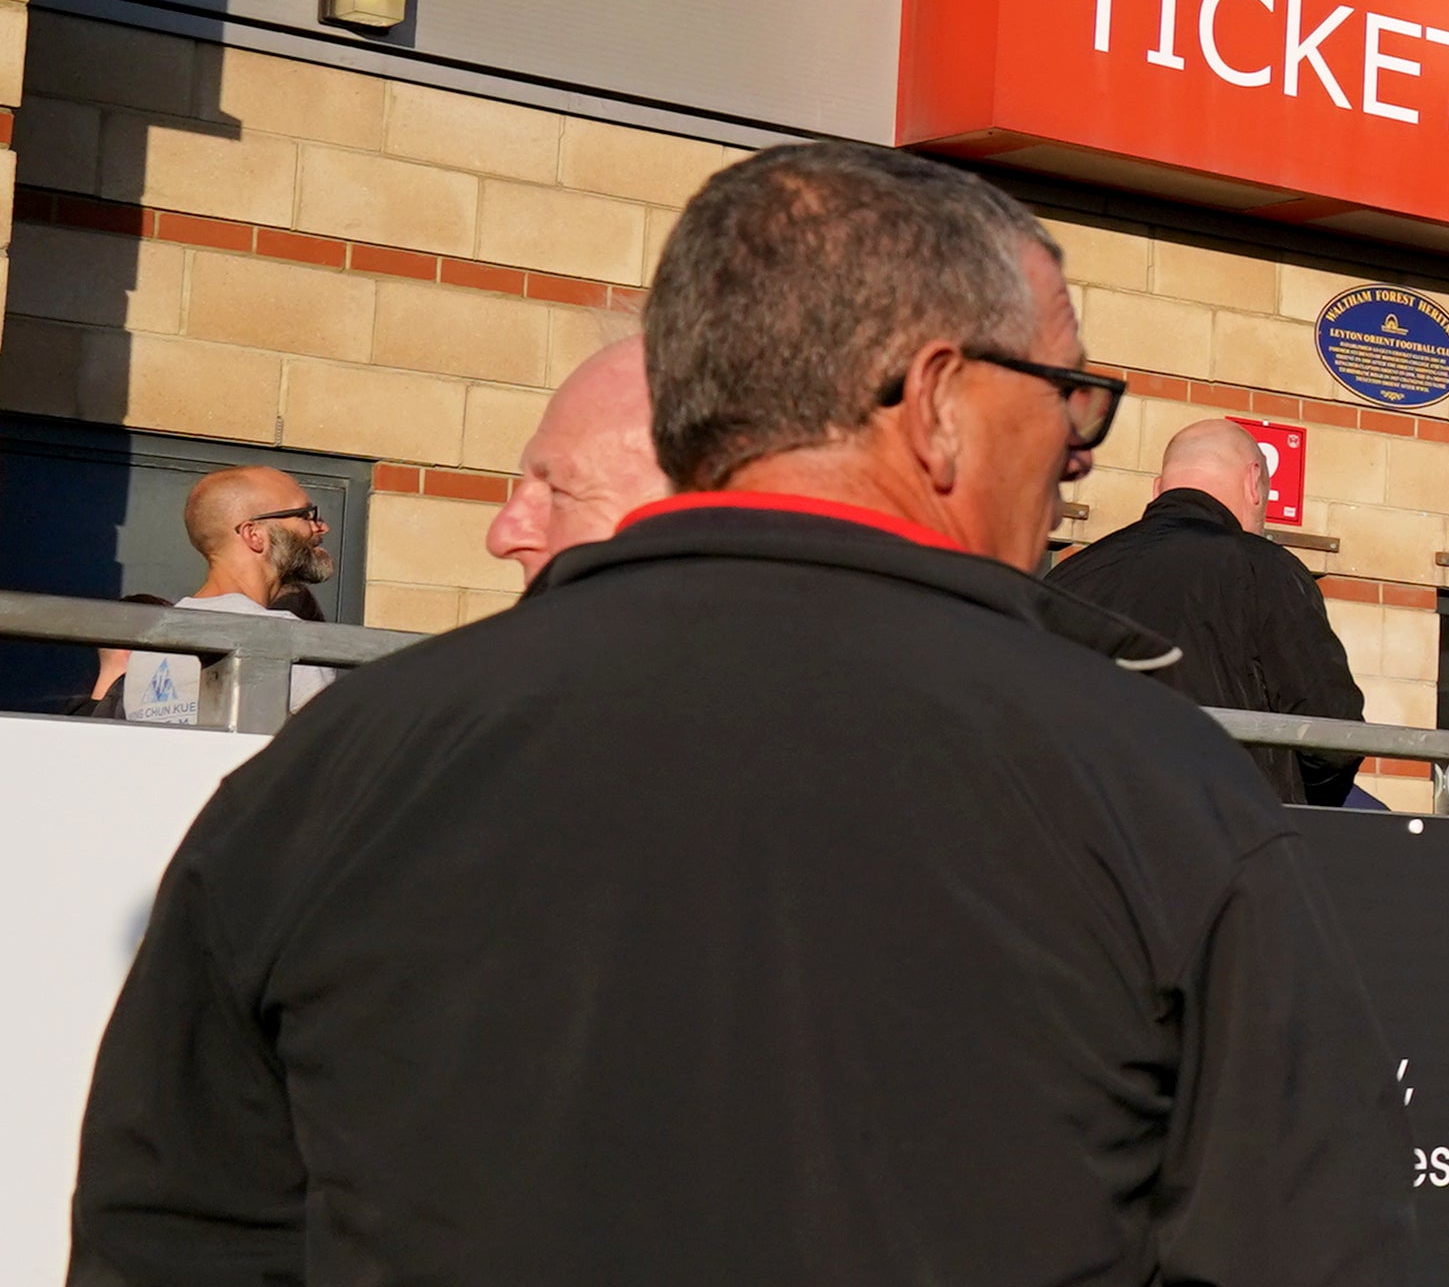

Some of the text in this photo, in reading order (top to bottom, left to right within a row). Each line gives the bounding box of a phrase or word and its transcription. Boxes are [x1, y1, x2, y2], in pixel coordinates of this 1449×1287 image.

[1325, 290, 1373, 322] WALTHAM
[1376, 289, 1416, 307] FOREST
[1330, 328, 1363, 341] LEYTON
[1363, 334, 1395, 347] ORIENT
[1395, 339, 1436, 354] FOOTBALL
